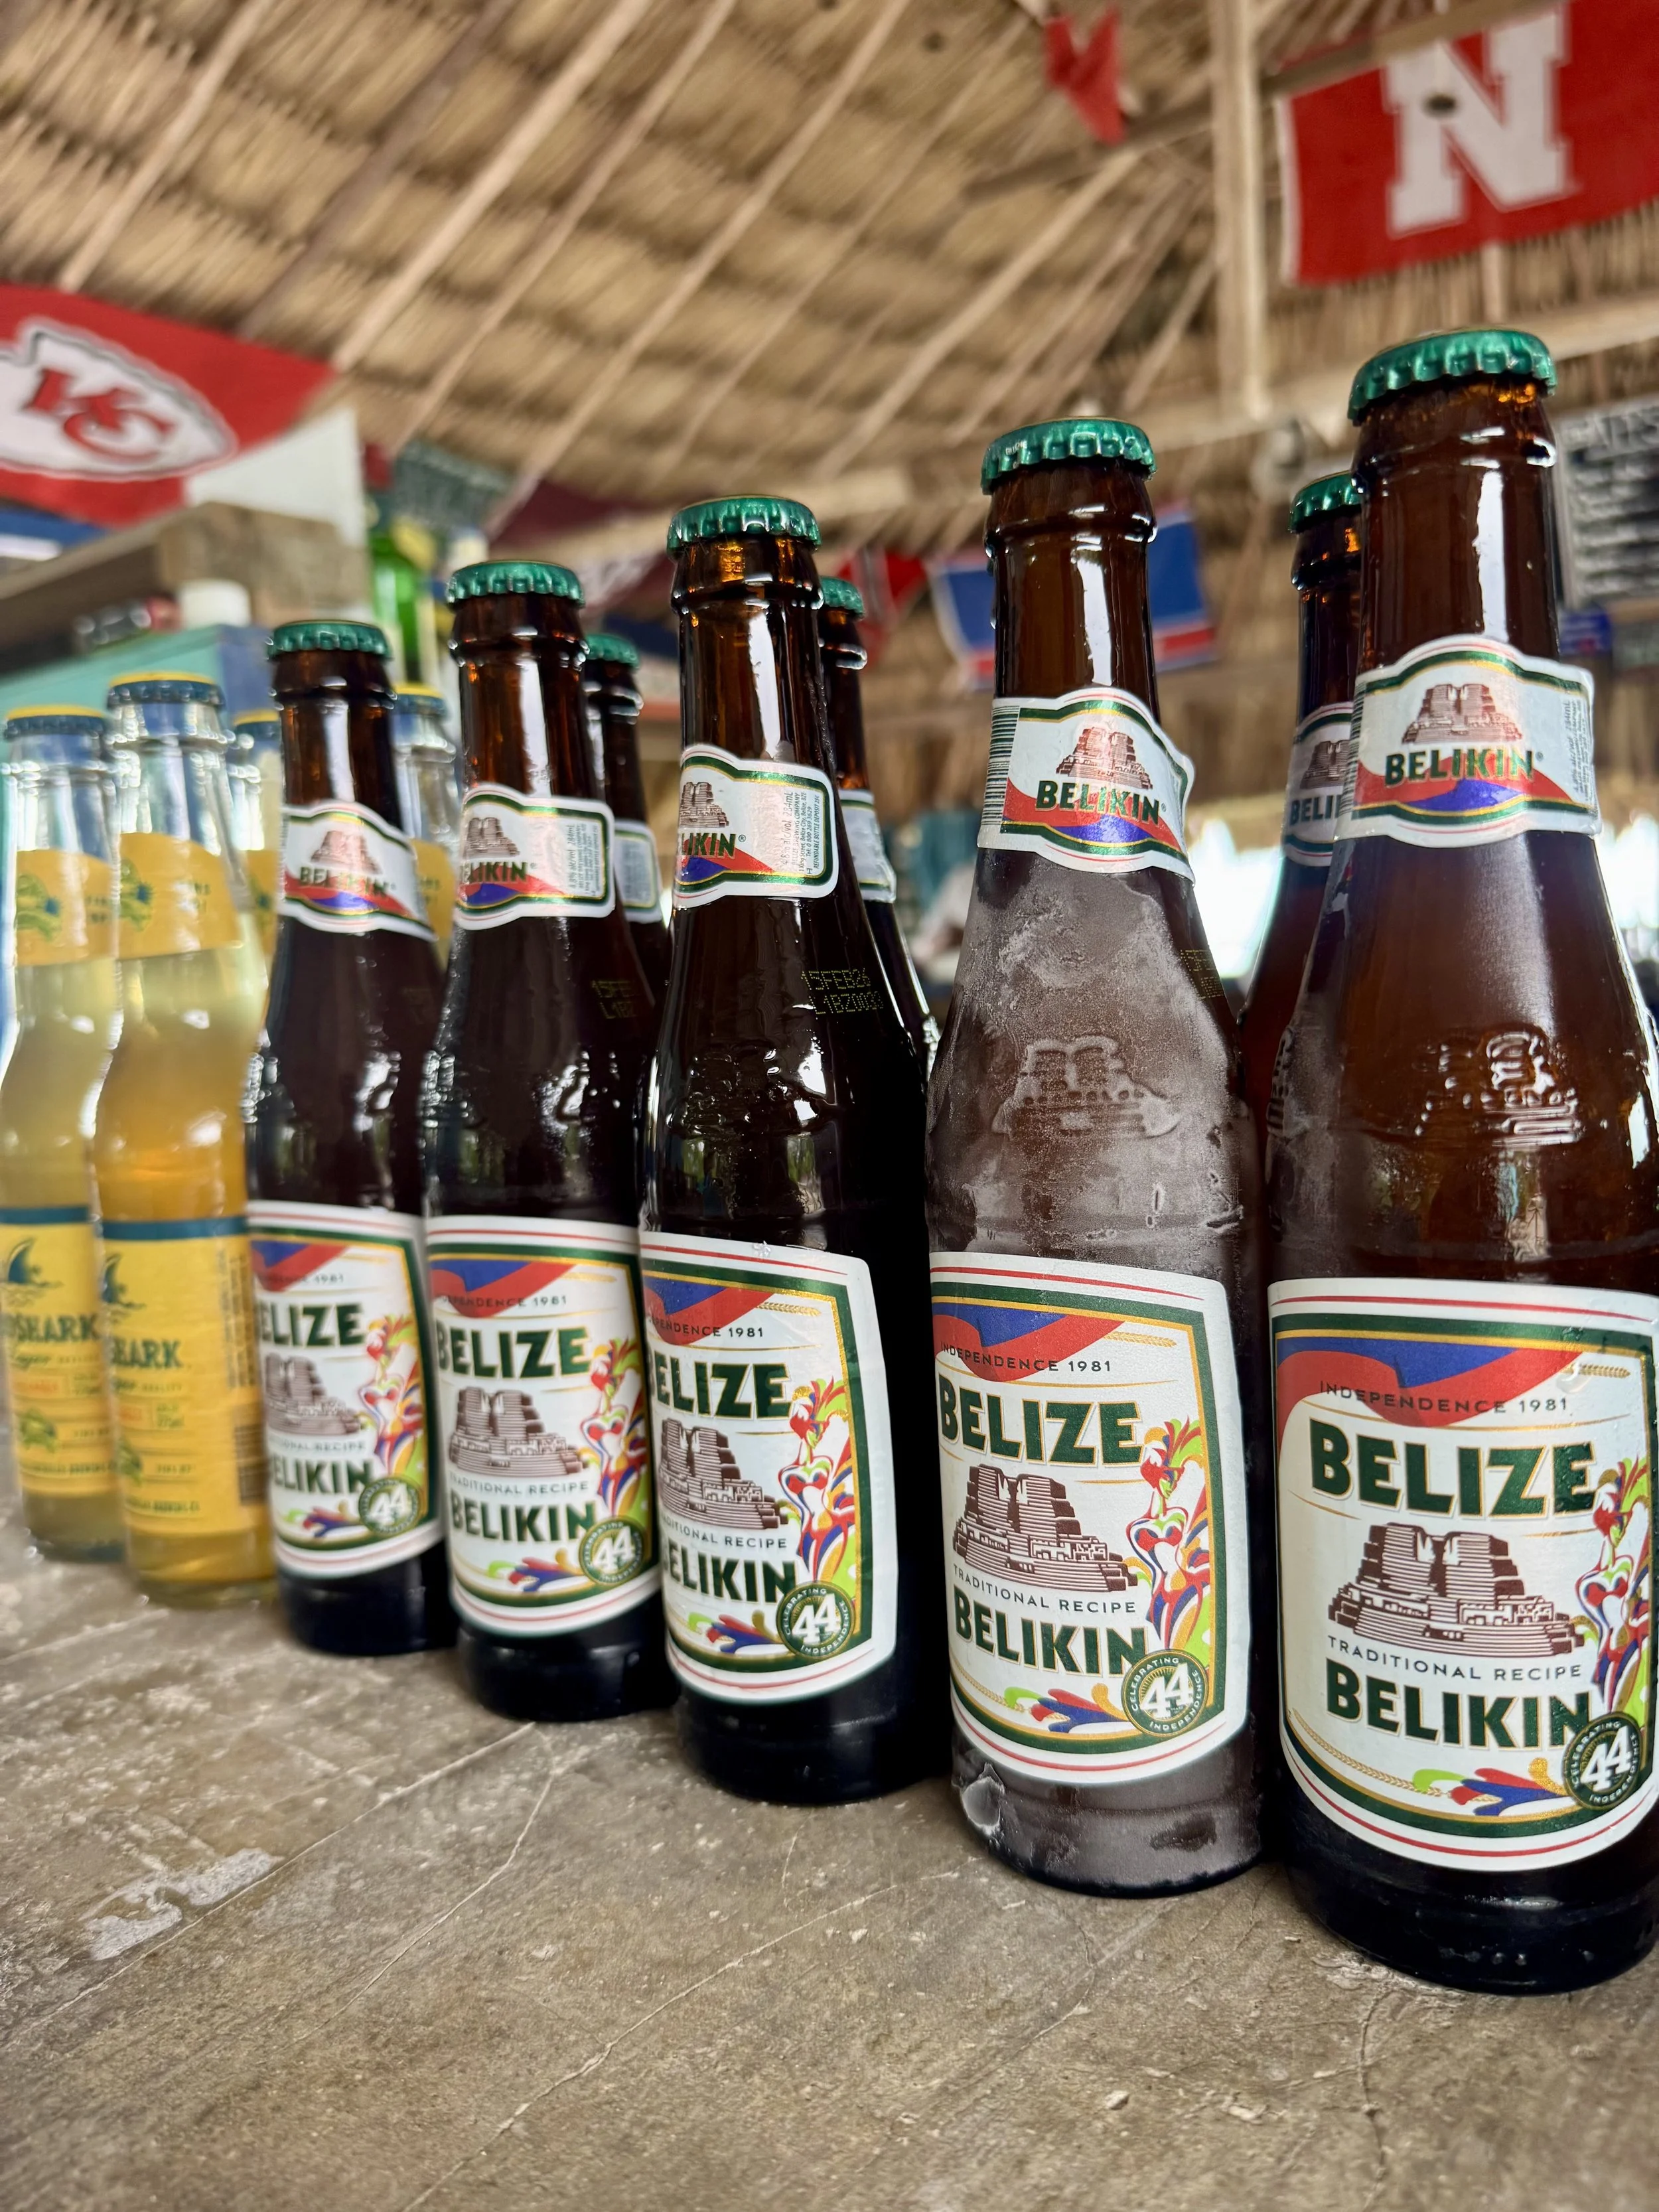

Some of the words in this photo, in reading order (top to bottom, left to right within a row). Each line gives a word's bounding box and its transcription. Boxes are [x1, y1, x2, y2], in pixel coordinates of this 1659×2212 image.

[1388, 13, 1571, 238] N
[782, 820, 792, 845] alc/vol
[801, 968, 871, 991] 15FEB26
[253, 1299, 365, 1347] ELIZE
[534, 1295, 567, 1306] 1981
[436, 1319, 591, 1379] BELIZE
[729, 1327, 764, 1338] 1981
[940, 1341, 1059, 1372] INDEPENDENCE
[1068, 1360, 1111, 1372] 1981
[649, 1350, 792, 1420] ELIZE
[1319, 1380, 1507, 1414] INDEPENDENCE
[1519, 1398, 1567, 1414] 1981
[938, 1372, 1144, 1465] BELIZE
[267, 1453, 372, 1493] ELIKIN
[529, 1481, 589, 1494] RECIPE
[1309, 1417, 1595, 1518] BELIZE
[368, 1483, 410, 1525] 44
[451, 1489, 596, 1542] BELIKIN
[592, 1526, 636, 1574] 44
[661, 1513, 718, 1544] ADITIONAL
[724, 1536, 788, 1549] RECIPE
[665, 1535, 797, 1603] ELIKIN
[952, 1564, 1050, 1609] TRADITIONAL
[1058, 1598, 1136, 1613] RECIPE
[785, 1587, 827, 1636] CELEBRATING
[792, 1593, 841, 1647] 44
[800, 1601, 850, 1655] INDEPENDENCE
[953, 1585, 1149, 1678] BELIKIN
[1129, 1657, 1180, 1712] CELEBRATING
[1327, 1635, 1481, 1679] TRADITIONAL
[1494, 1664, 1582, 1681] RECIPE
[1139, 1662, 1194, 1720] 44
[1149, 1669, 1203, 1731] INDEPENDENCE
[1326, 1658, 1591, 1750] BELIKIN
[1570, 1721, 1621, 1789] CELEBRATING
[1579, 1726, 1632, 1792] 44
